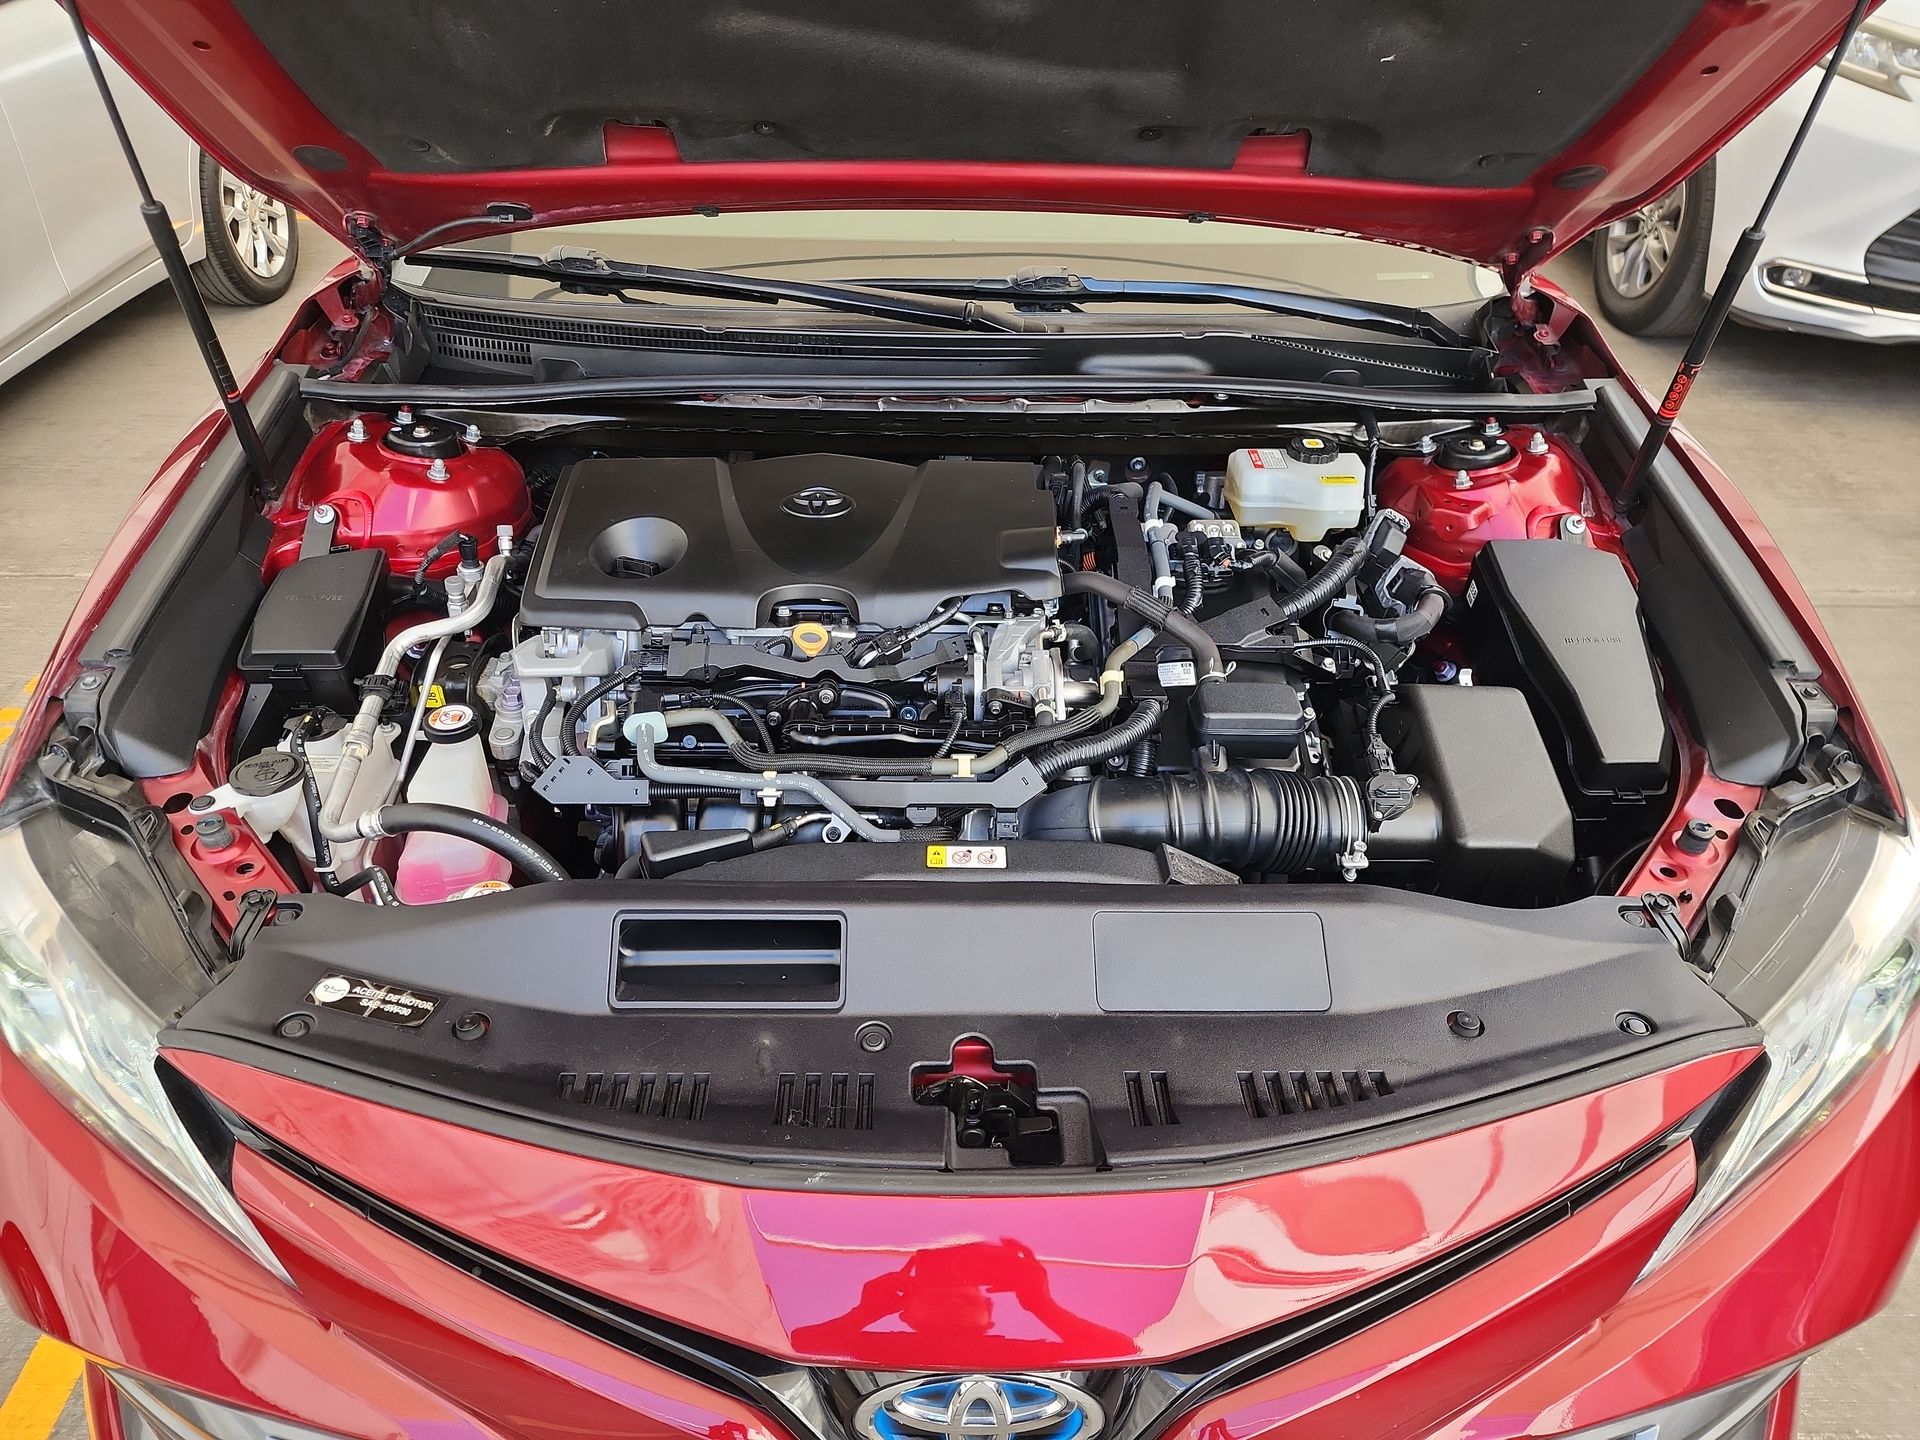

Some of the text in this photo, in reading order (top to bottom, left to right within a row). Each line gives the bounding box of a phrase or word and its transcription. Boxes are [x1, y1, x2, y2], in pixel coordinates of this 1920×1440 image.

[352, 985, 434, 1010] ACEITE DE MOTOR
